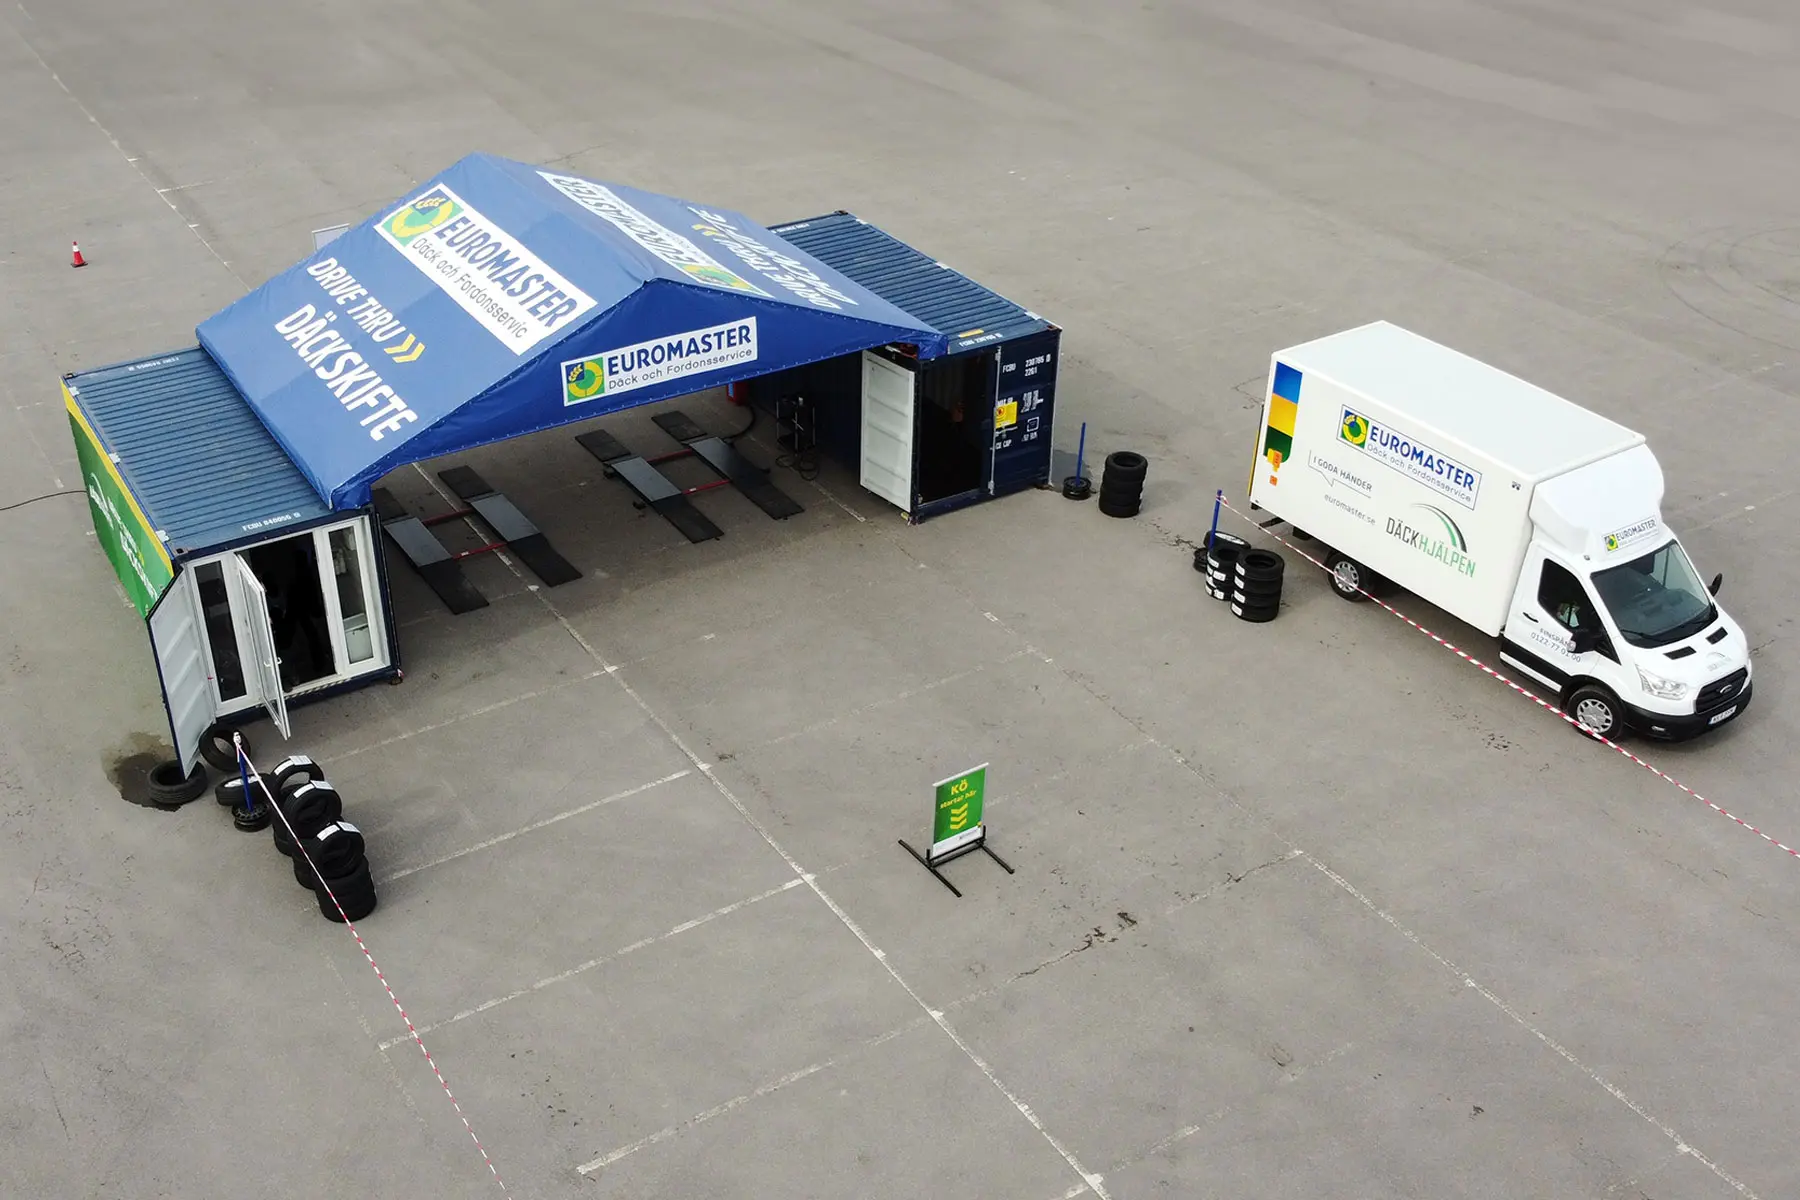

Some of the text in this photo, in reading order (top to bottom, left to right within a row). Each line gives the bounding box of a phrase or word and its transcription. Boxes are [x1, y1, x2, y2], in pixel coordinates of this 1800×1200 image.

[307, 257, 406, 343] DRIVE THRU
[412, 238, 528, 339] Däck och Fordonsservic
[434, 216, 577, 327] EUROMASTER
[275, 303, 418, 441] DÄCKSKIFTE
[608, 325, 752, 376] EUROMASTER
[609, 349, 752, 390] Däck och Fordonsservice
[1318, 458, 1338, 474] GODA
[1367, 443, 1471, 502] Däck och Fordonsservice
[1370, 425, 1474, 492] EUROMASTER
[1324, 494, 1376, 525] euromaster.se
[1616, 519, 1656, 541] EUROMASTER
[1386, 516, 1476, 578] DÄCKHJÄLPEN
[951, 779, 969, 796] KÖ
